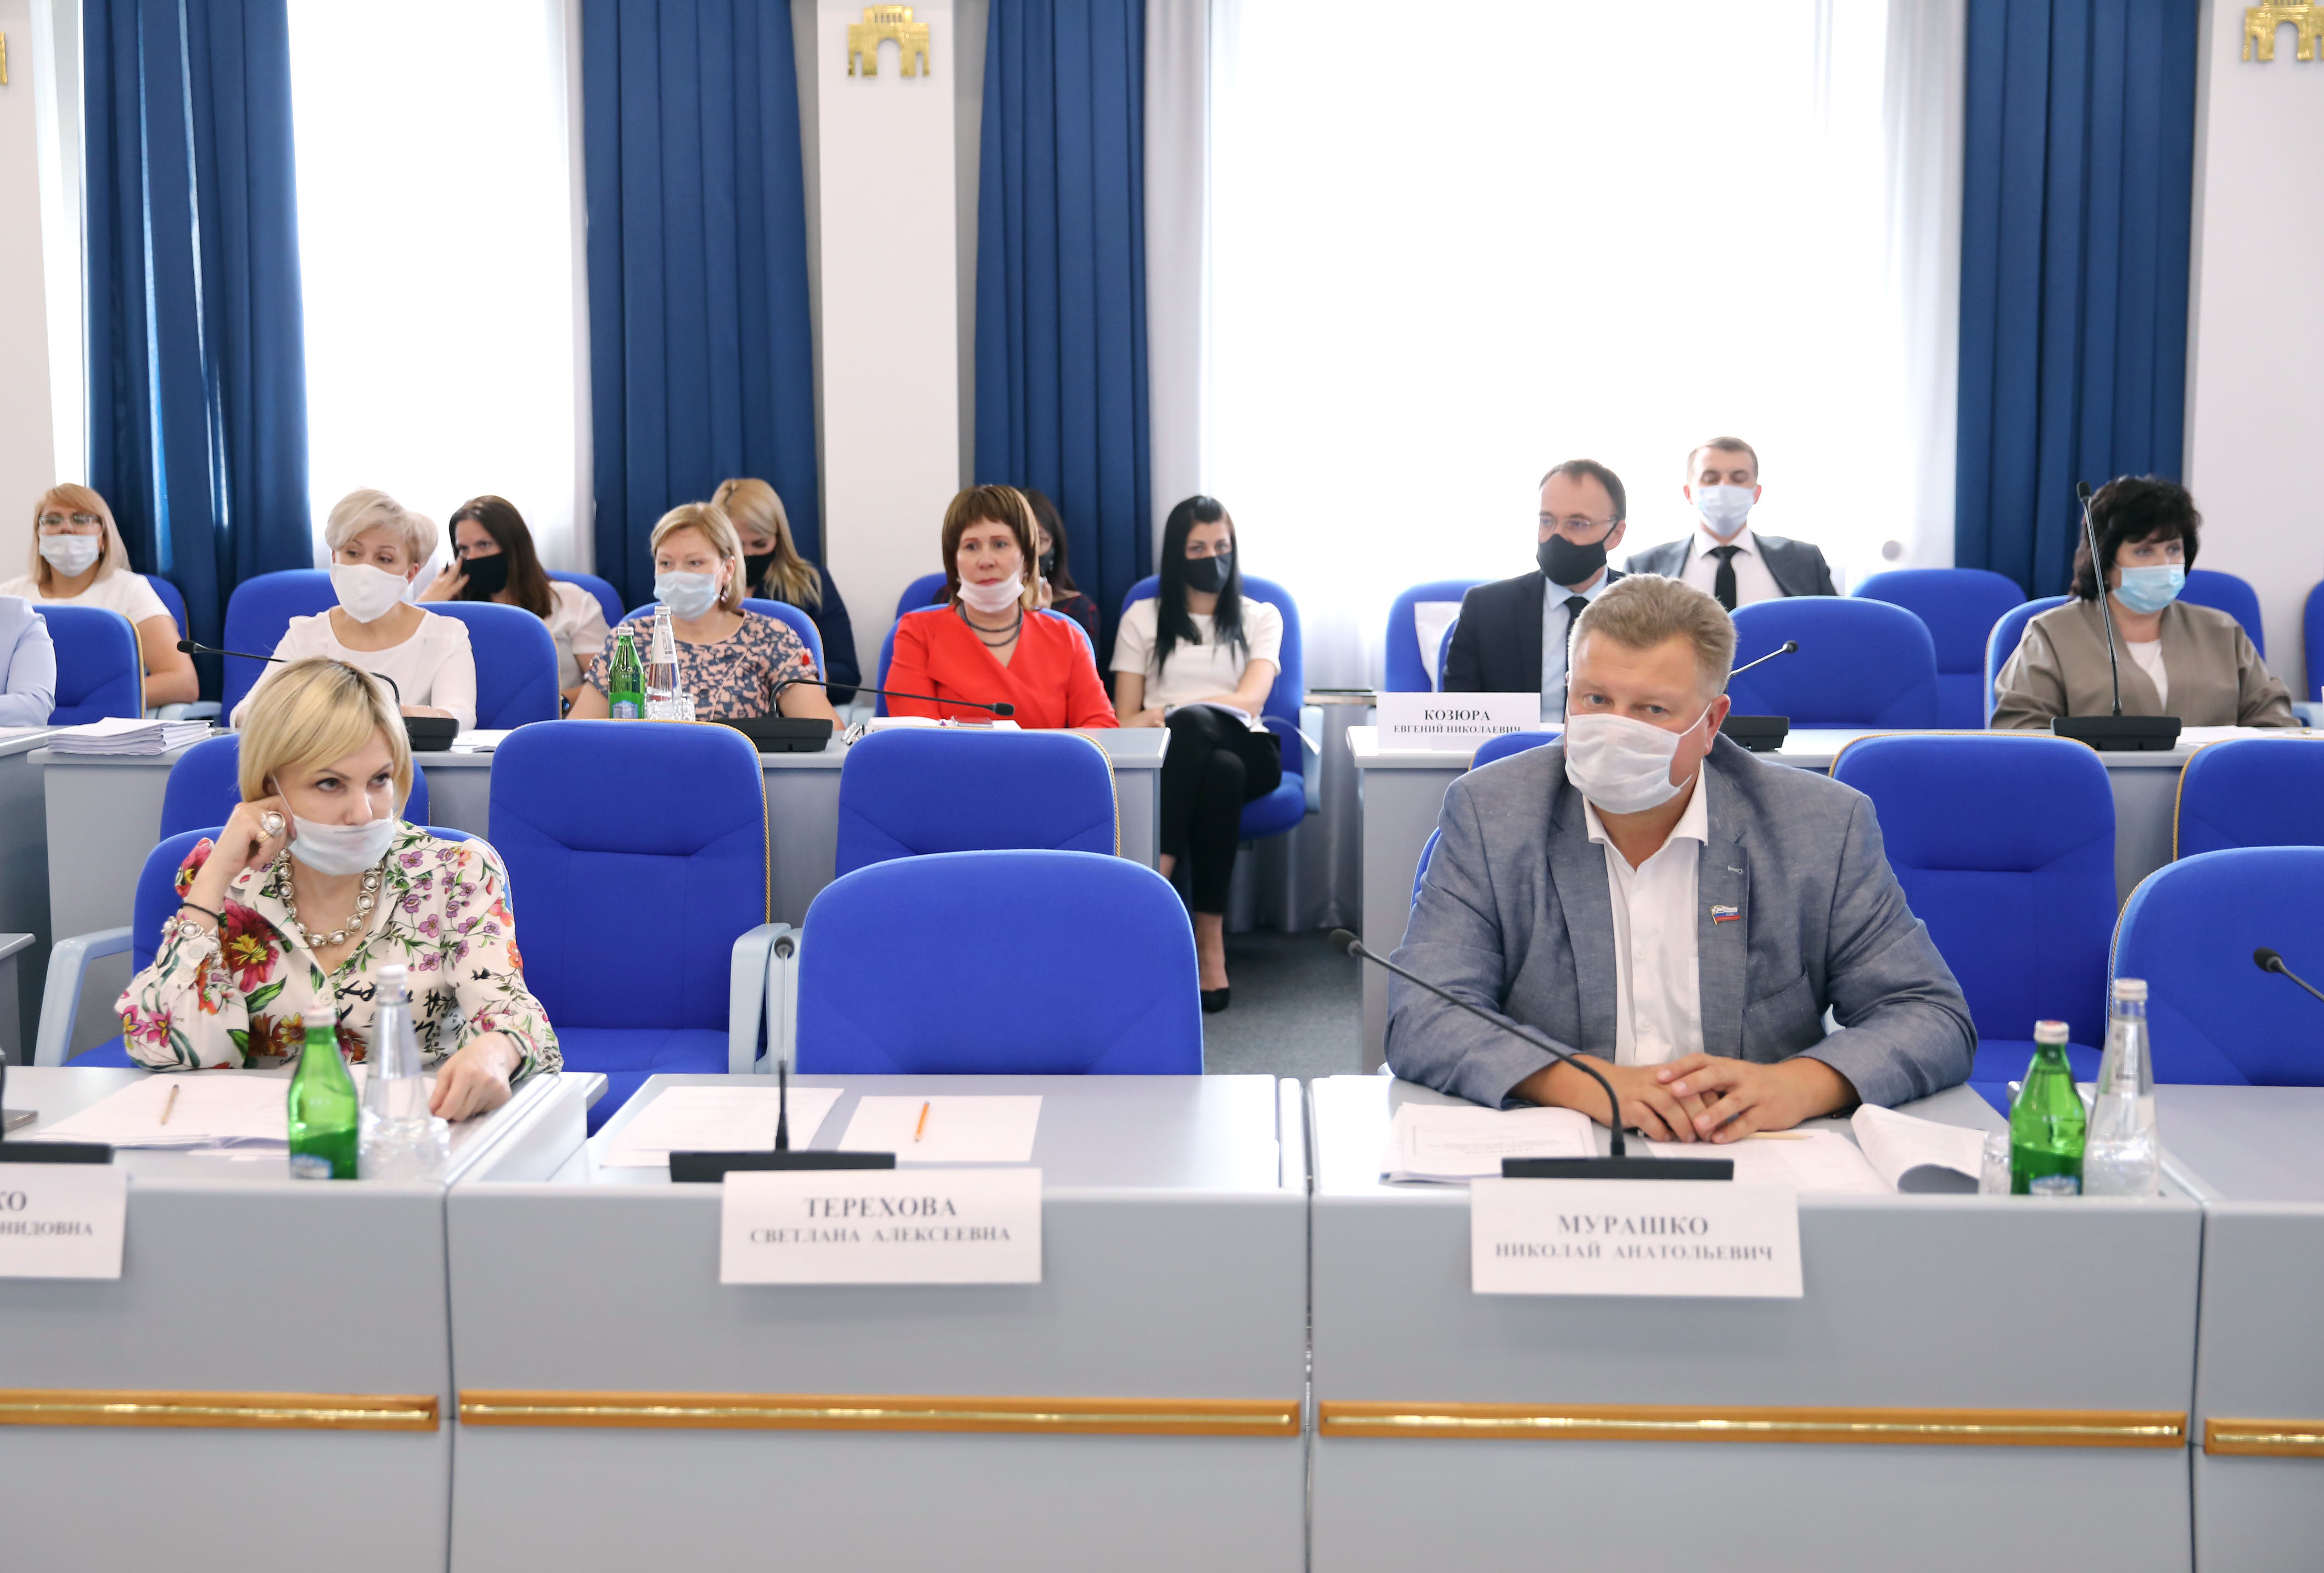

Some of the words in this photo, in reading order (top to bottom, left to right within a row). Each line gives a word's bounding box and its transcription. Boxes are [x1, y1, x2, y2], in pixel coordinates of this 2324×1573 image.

[1424, 709, 1490, 721] КОЗЮРА
[1394, 724, 1443, 733] ЕВГЕНИЙ
[1447, 725, 1520, 734] НИКОЛАЕВИЧ
[805, 1197, 957, 1218] ТЕРЕХОВА
[750, 1228, 861, 1244] СВЕТЛАНА
[873, 1226, 1011, 1242] АЛЕКСЕЕВНА
[1558, 1215, 1708, 1236] МУРАШКО
[1496, 1241, 1601, 1258] НИКОЛАЙ
[1614, 1244, 1773, 1261] АНАТОЛЬЕВИЧ
